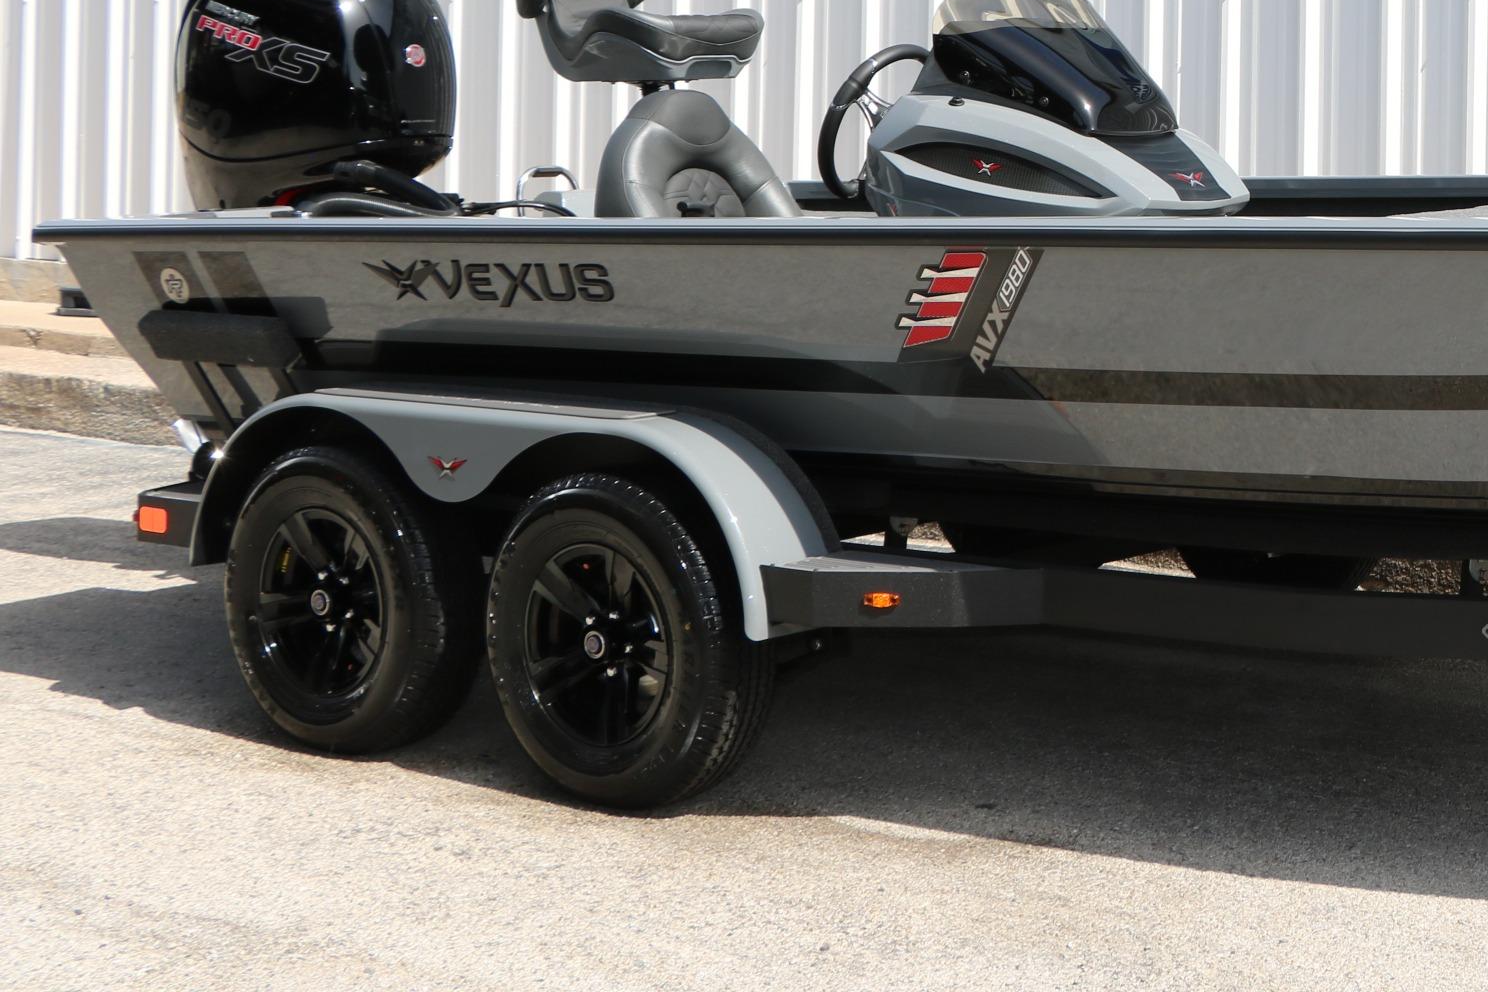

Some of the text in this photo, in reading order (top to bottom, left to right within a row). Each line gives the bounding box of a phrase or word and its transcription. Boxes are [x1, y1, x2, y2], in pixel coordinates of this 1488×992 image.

[196, 14, 331, 84] PRO XS
[420, 259, 615, 308] VEXUS
[970, 249, 1032, 374] AVX 1980
